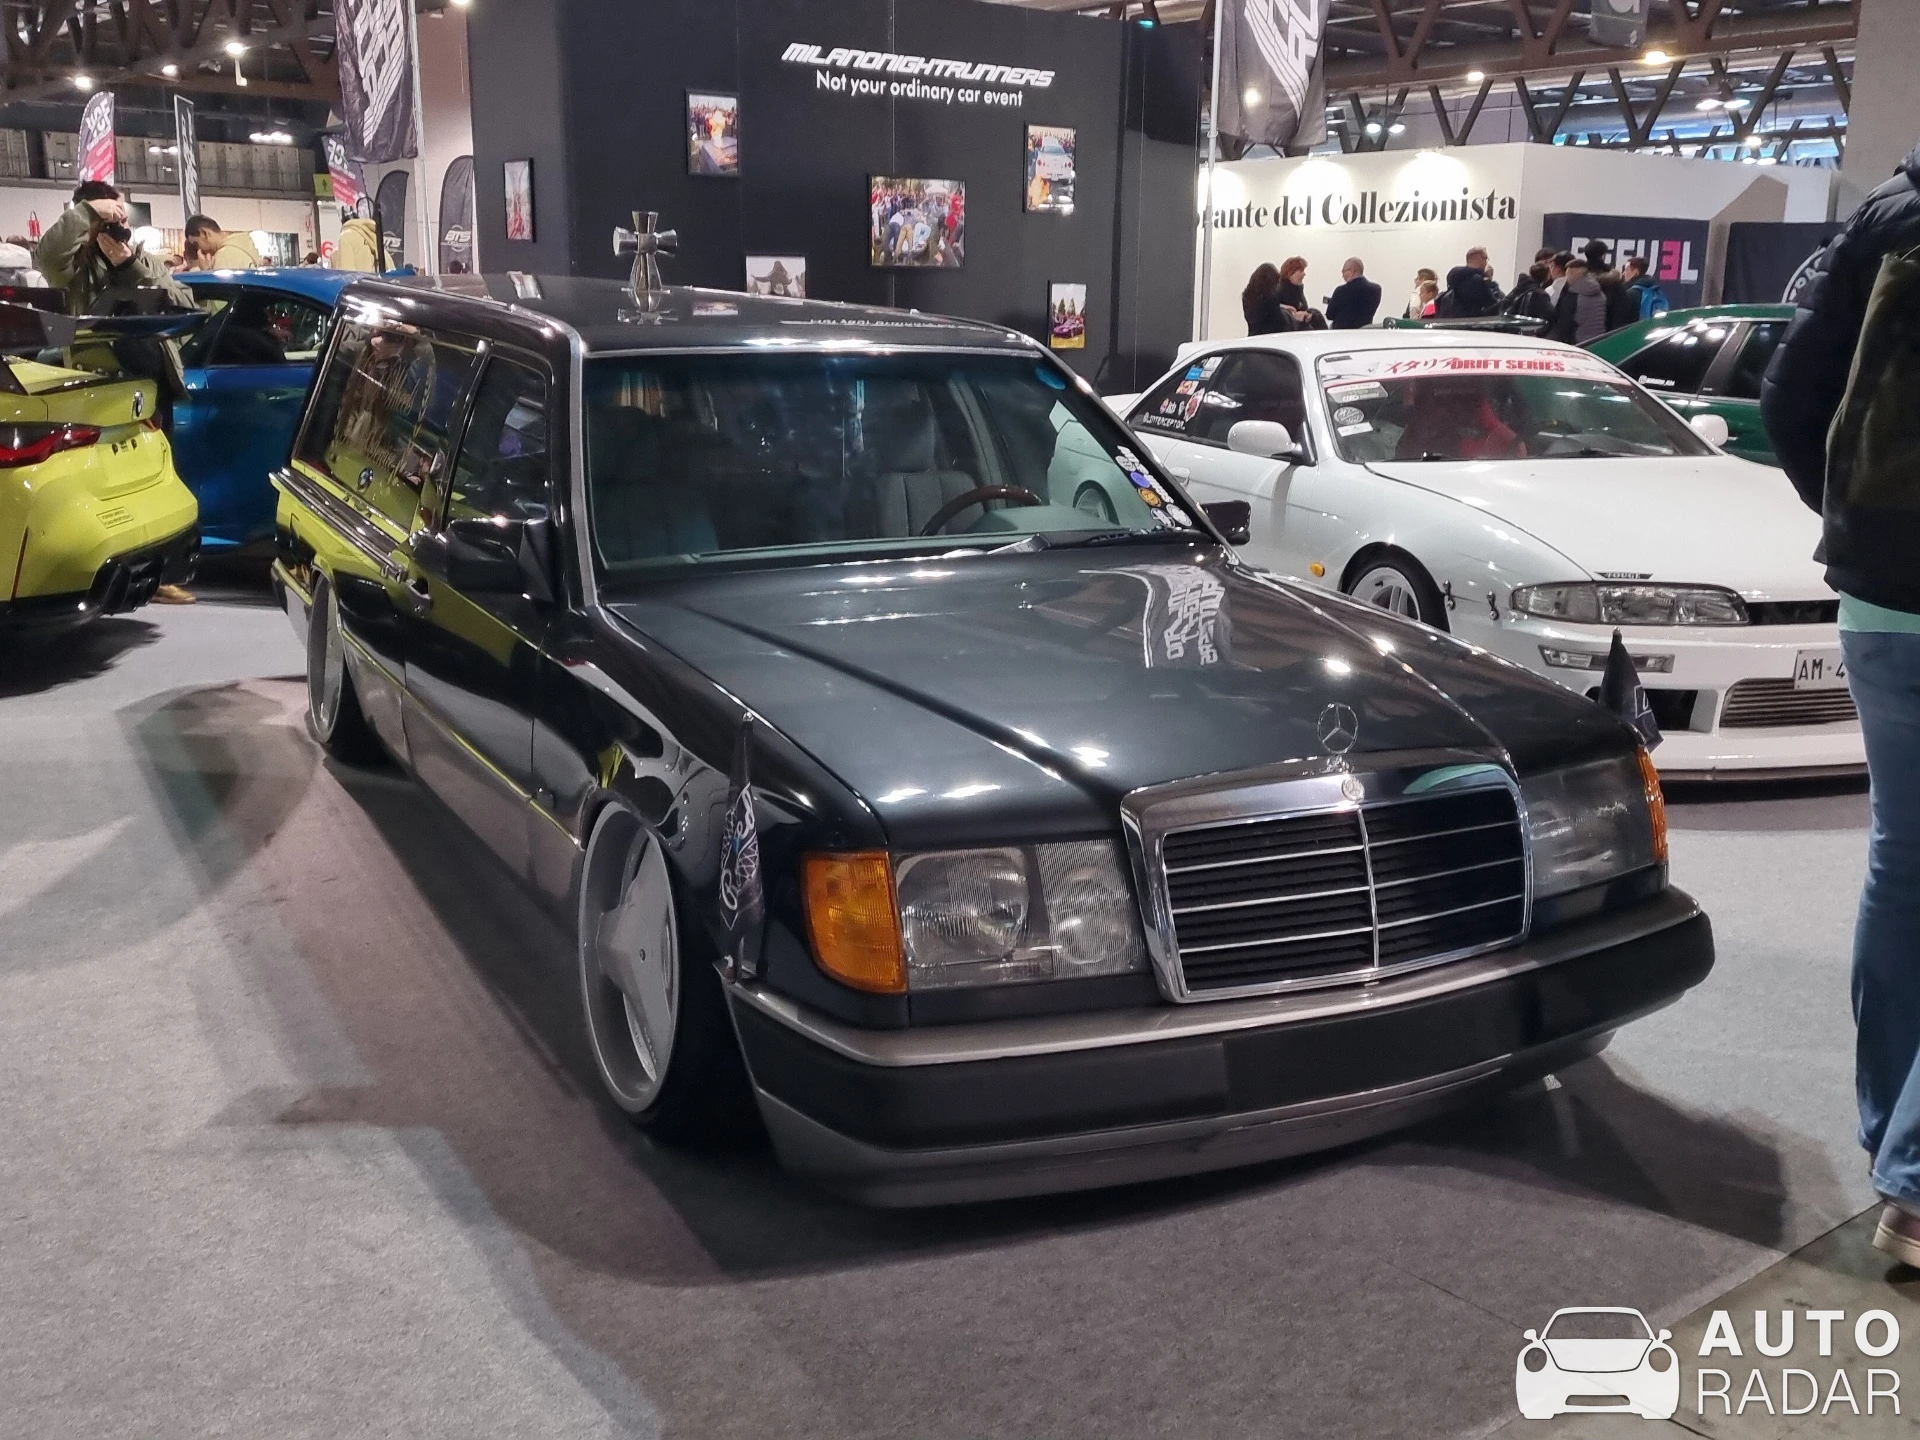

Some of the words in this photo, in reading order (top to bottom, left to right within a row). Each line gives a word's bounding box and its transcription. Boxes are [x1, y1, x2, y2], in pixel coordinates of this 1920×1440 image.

[781, 42, 1055, 87] MILANONIGHTRUNNERS
[816, 69, 847, 91] Not
[850, 76, 887, 96] your
[889, 78, 954, 105] ordinary
[957, 86, 980, 104] car
[983, 89, 1023, 107] event
[1273, 195, 1312, 227] del
[1321, 186, 1517, 226] Collezionista
[1450, 358, 1502, 371] DRIFT
[1505, 358, 1566, 373] SERIES
